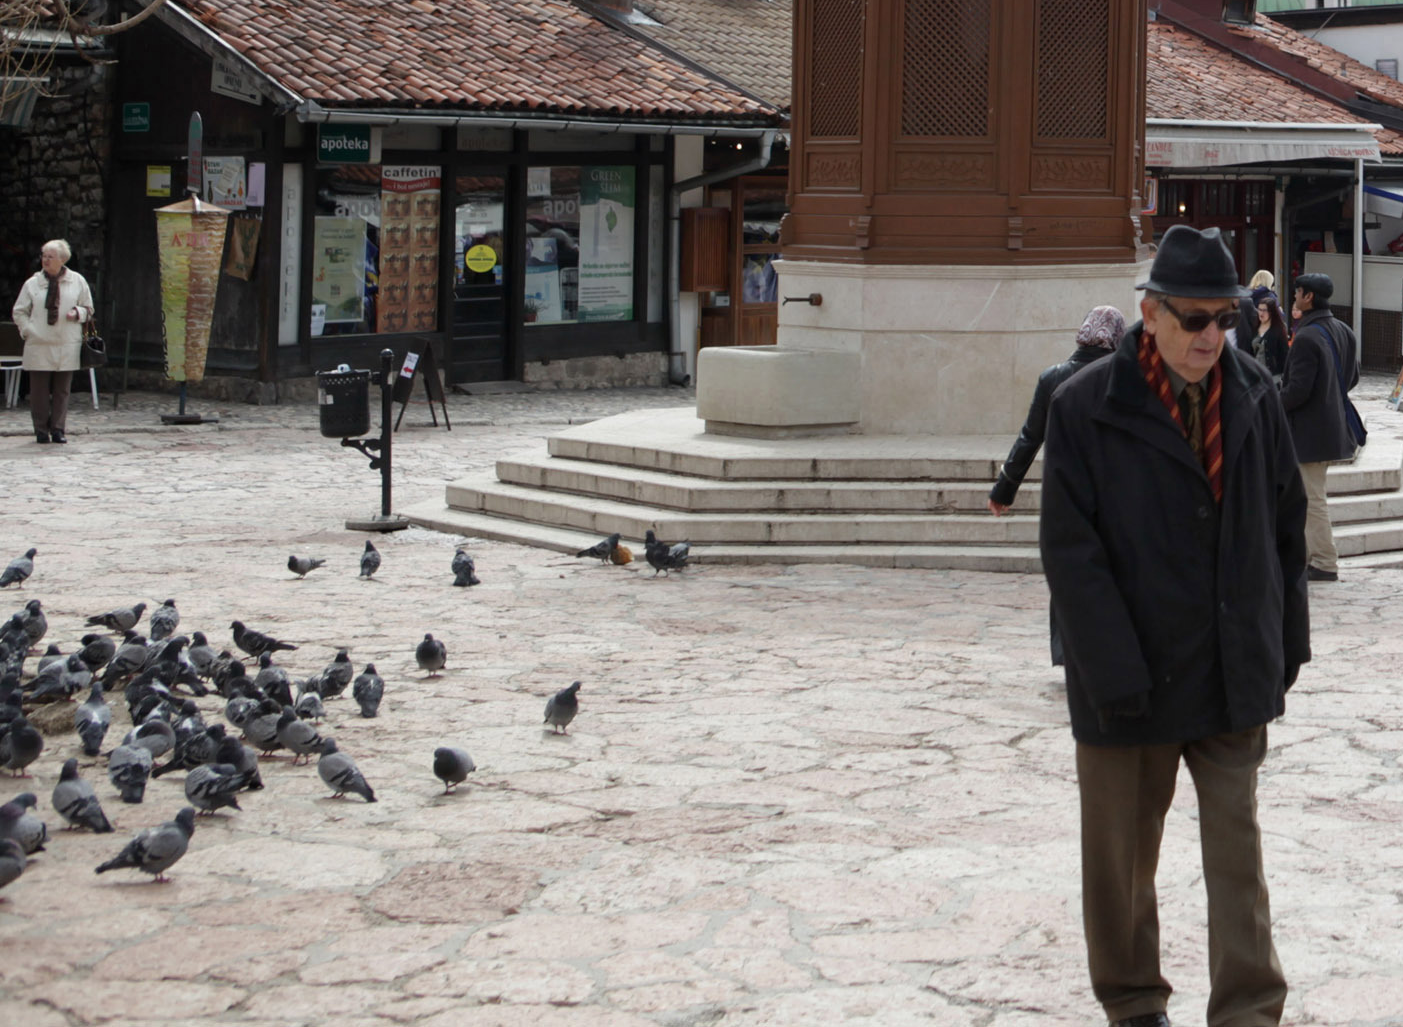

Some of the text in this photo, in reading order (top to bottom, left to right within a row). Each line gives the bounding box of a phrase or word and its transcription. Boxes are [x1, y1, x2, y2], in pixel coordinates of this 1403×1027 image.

[320, 135, 369, 152] apoteka
[384, 167, 437, 178] caffetin
[591, 169, 621, 181] GREEN
[600, 182, 621, 193] SLIM
[543, 197, 579, 219] apo
